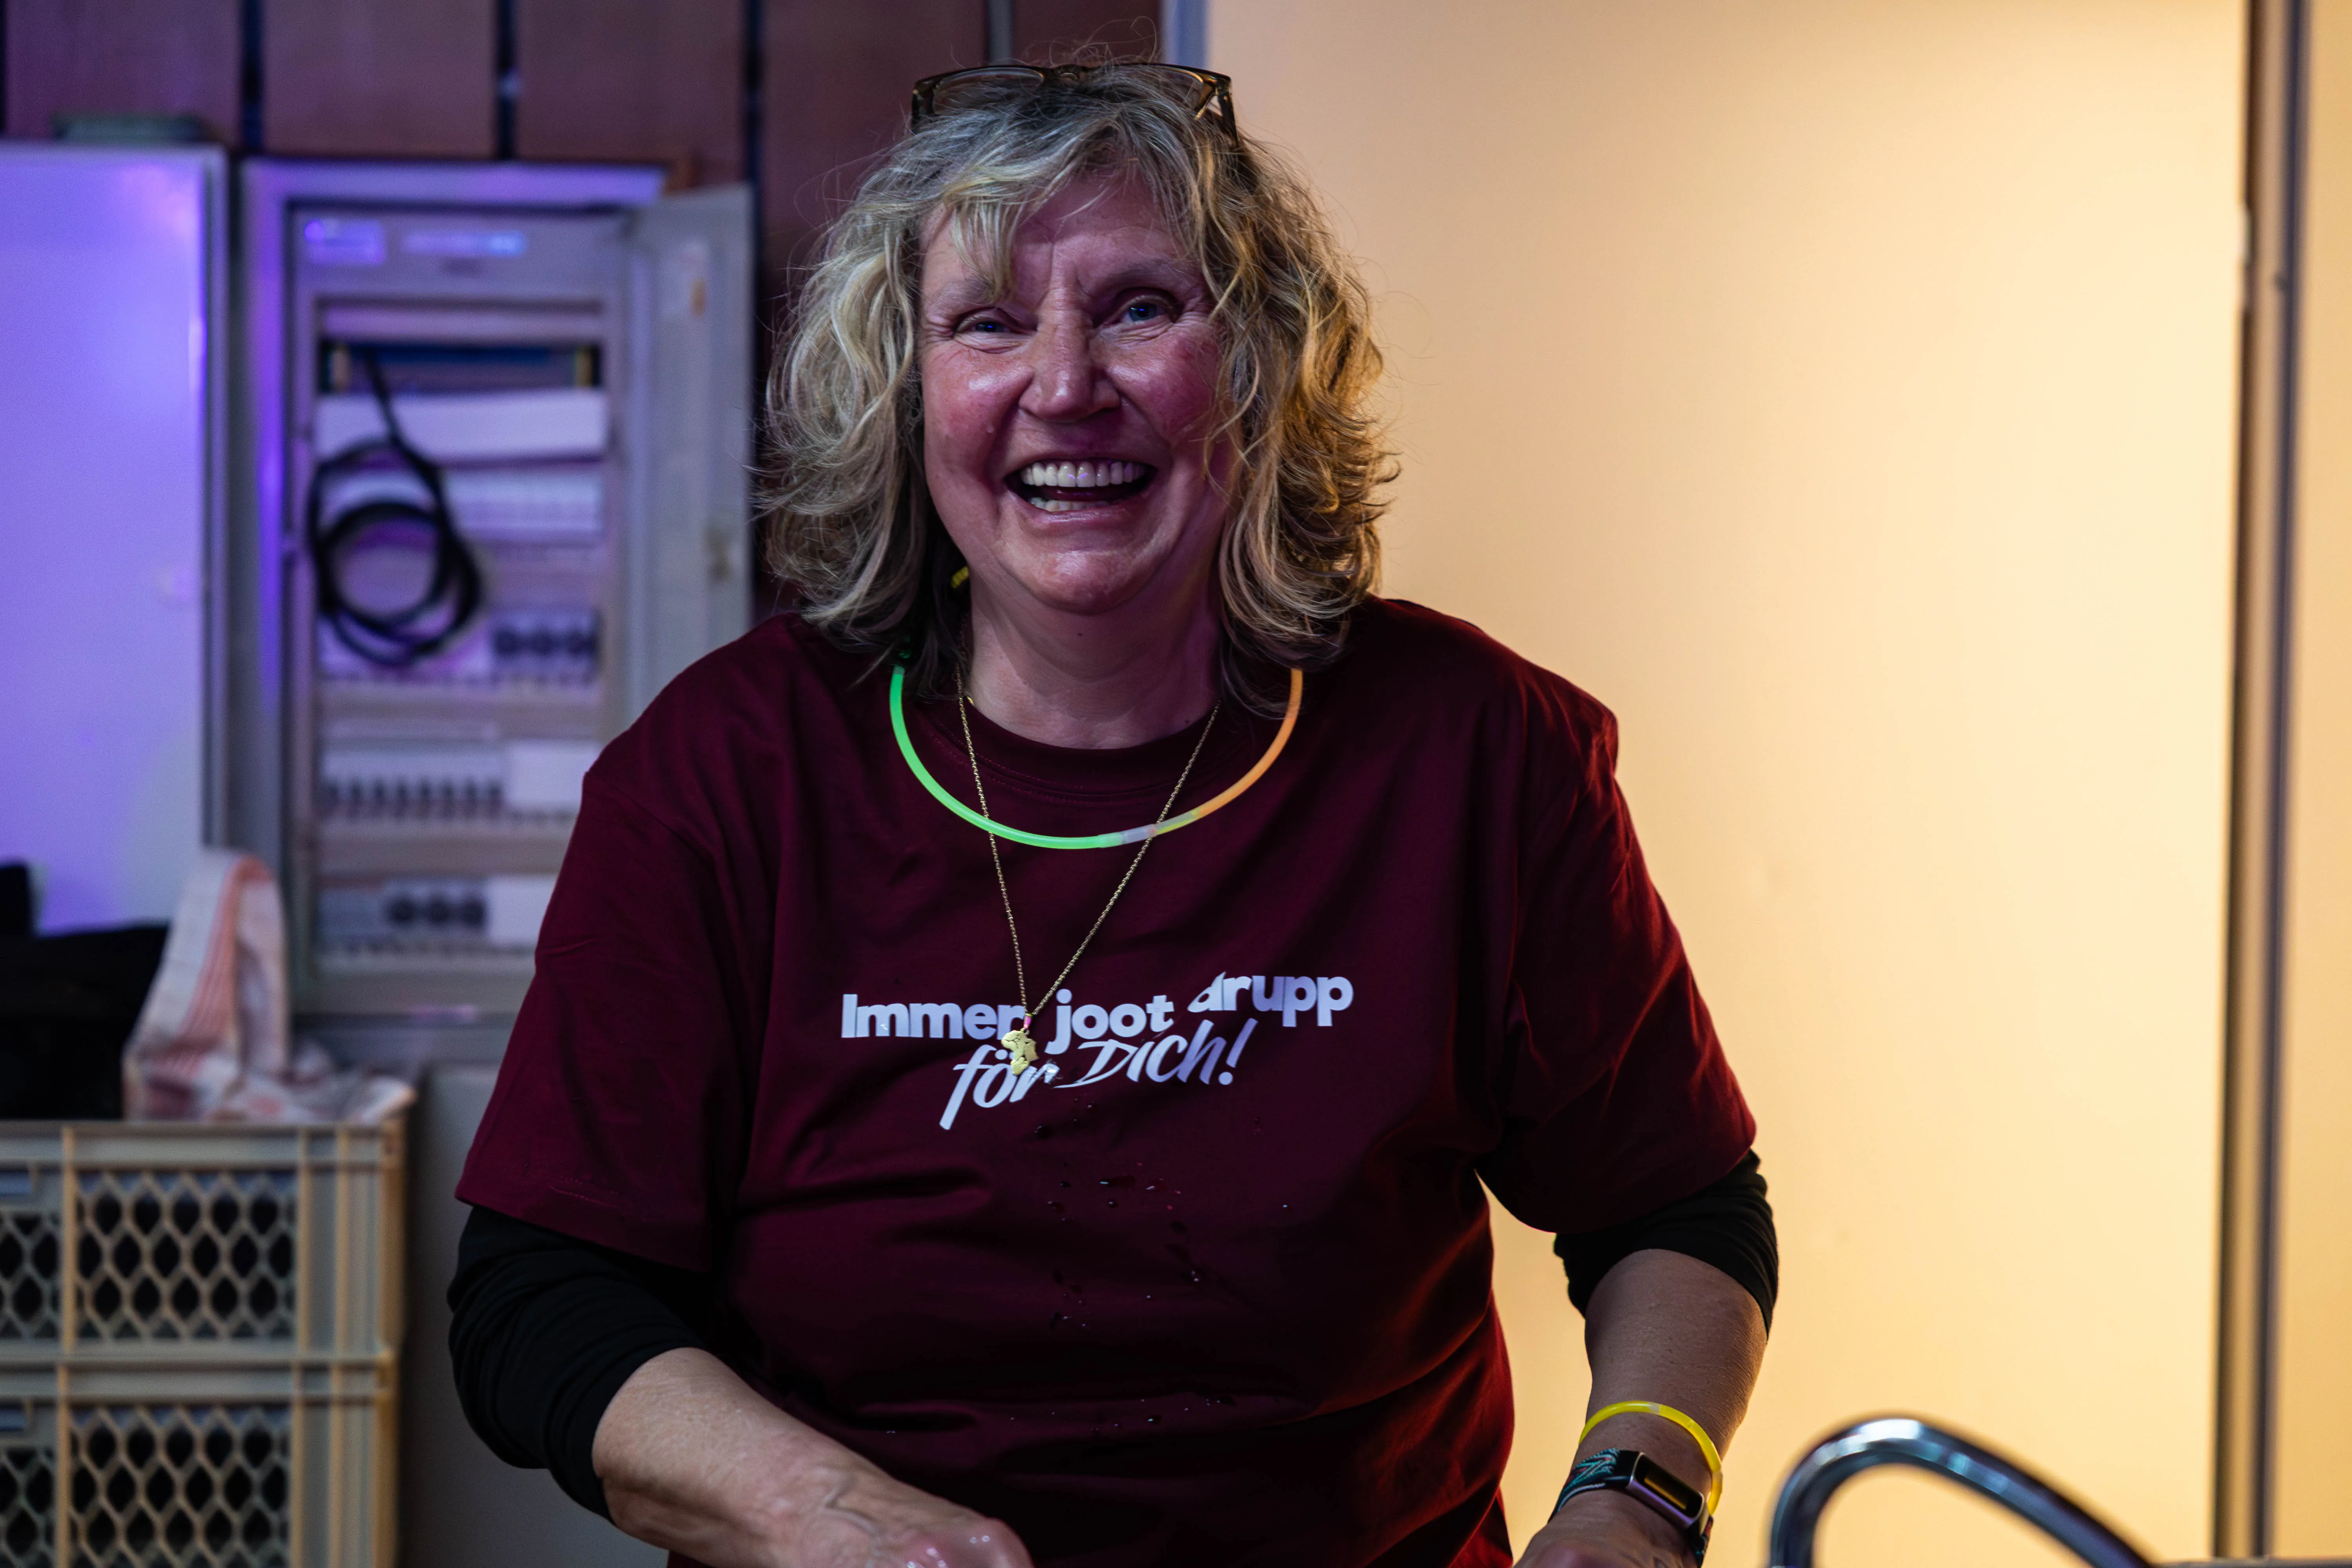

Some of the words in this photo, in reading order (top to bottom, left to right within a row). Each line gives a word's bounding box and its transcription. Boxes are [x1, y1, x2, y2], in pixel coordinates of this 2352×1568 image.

[841, 993, 1027, 1040] Immer
[1044, 988, 1174, 1055] joot
[1187, 971, 1354, 1027] drupp
[939, 1044, 1060, 1131] för
